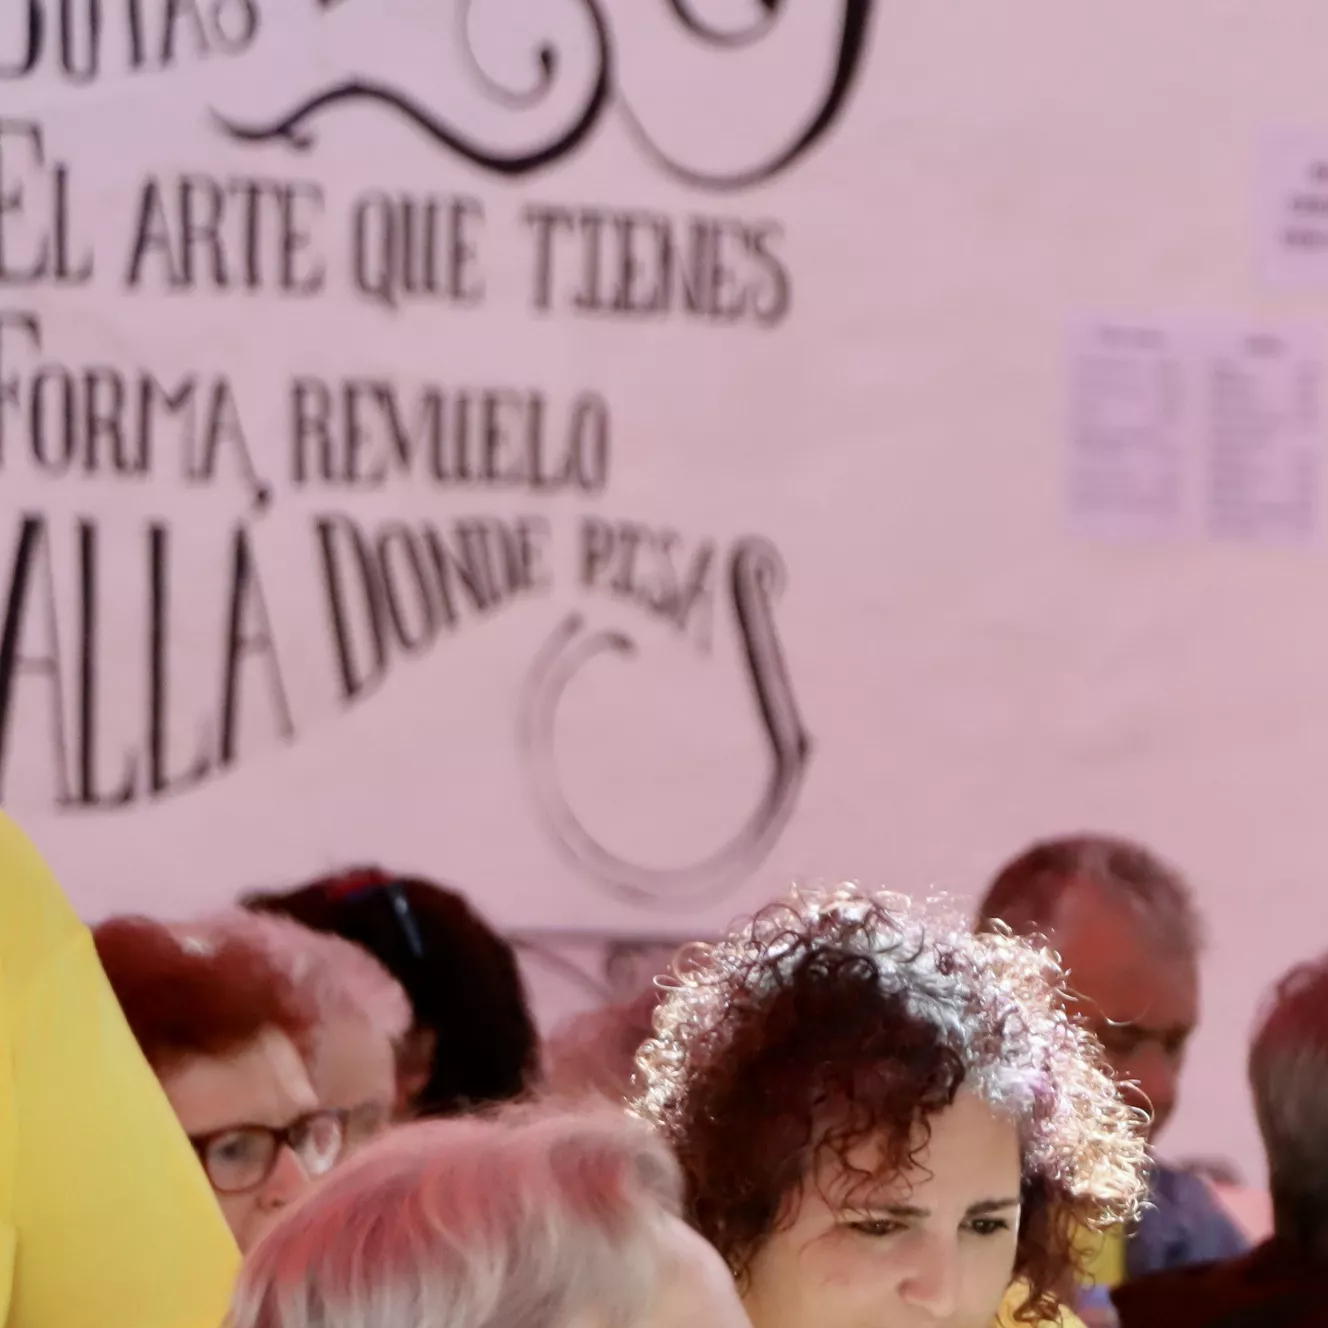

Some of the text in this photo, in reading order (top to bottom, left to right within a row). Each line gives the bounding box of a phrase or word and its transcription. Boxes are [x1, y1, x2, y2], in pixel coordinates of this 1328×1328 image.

[124, 170, 327, 296] ARTE
[351, 190, 487, 310] QUE
[521, 202, 793, 332] TIENES
[290, 374, 614, 492] REVUELO
[314, 512, 553, 708] DONDE
